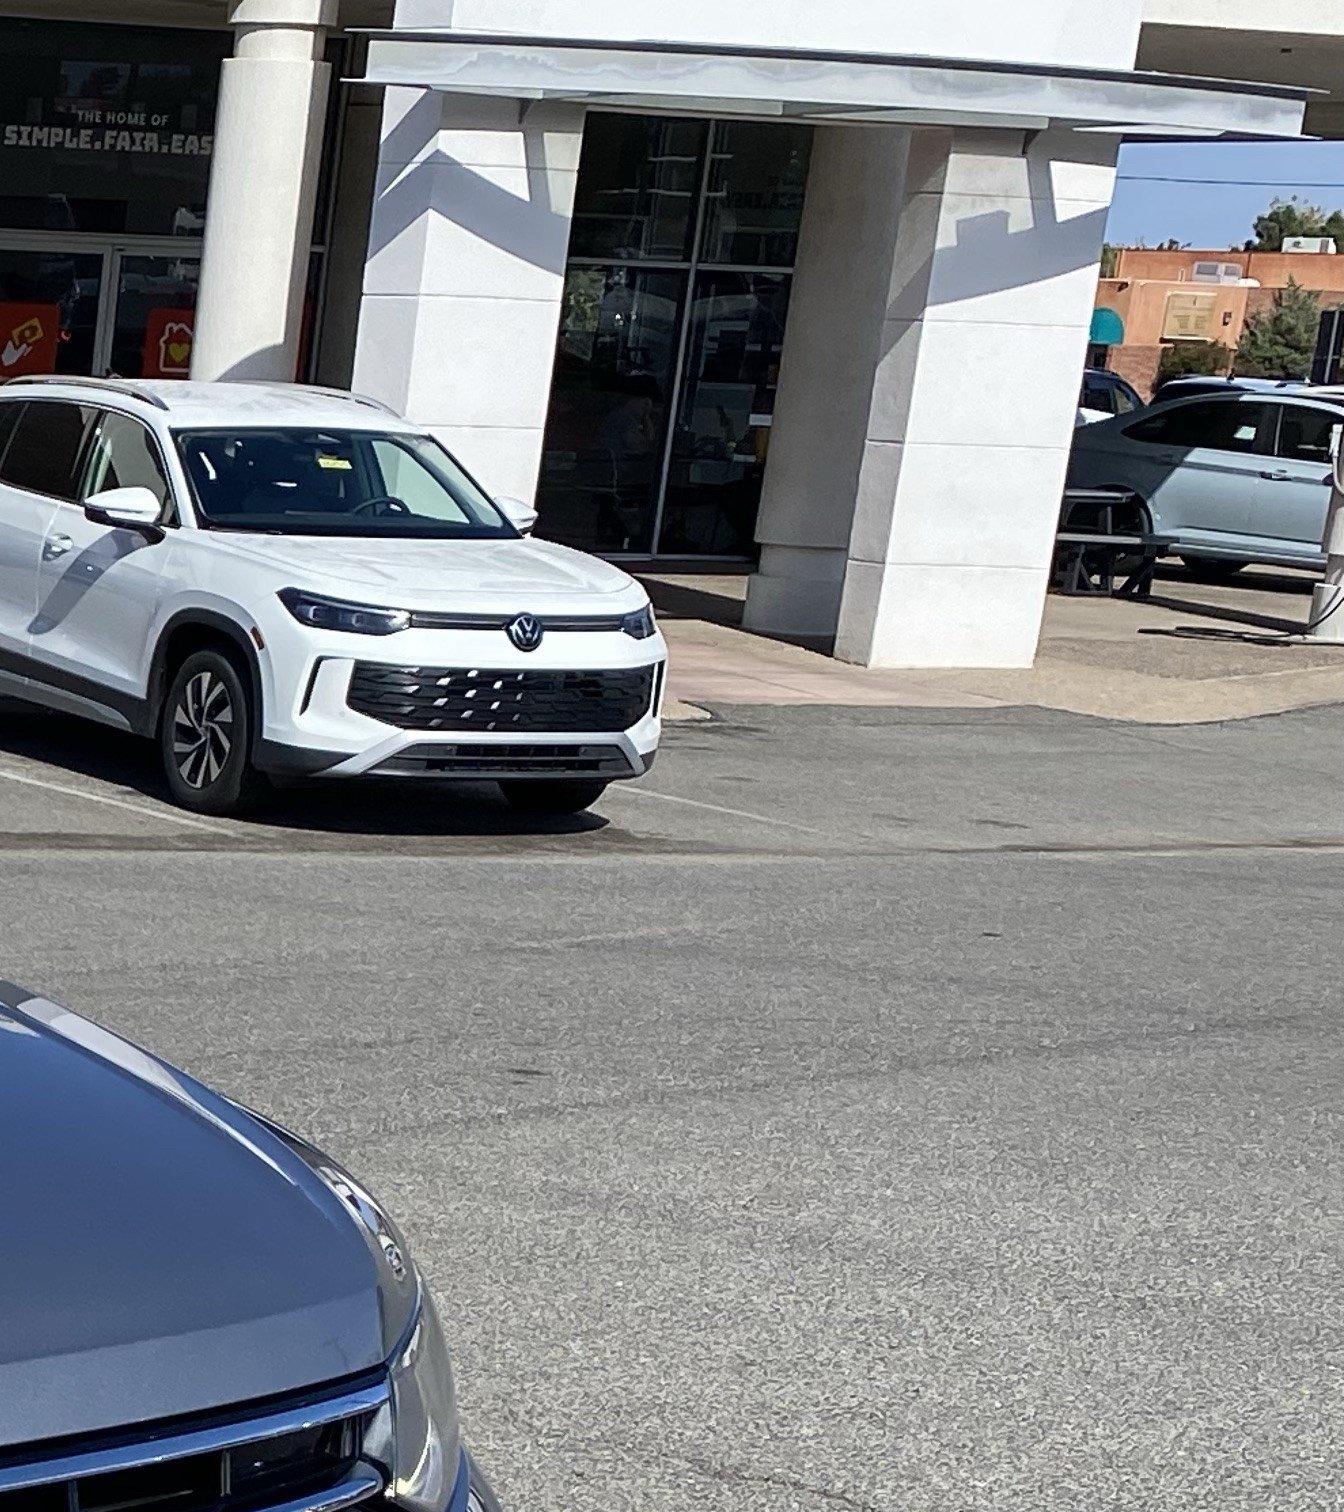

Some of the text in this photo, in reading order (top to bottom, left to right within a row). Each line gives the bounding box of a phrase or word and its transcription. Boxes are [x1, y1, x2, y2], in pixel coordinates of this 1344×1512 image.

[77, 110, 169, 126] THE HOME OF
[3, 124, 214, 156] SIMPLE.FAIR.EAS
